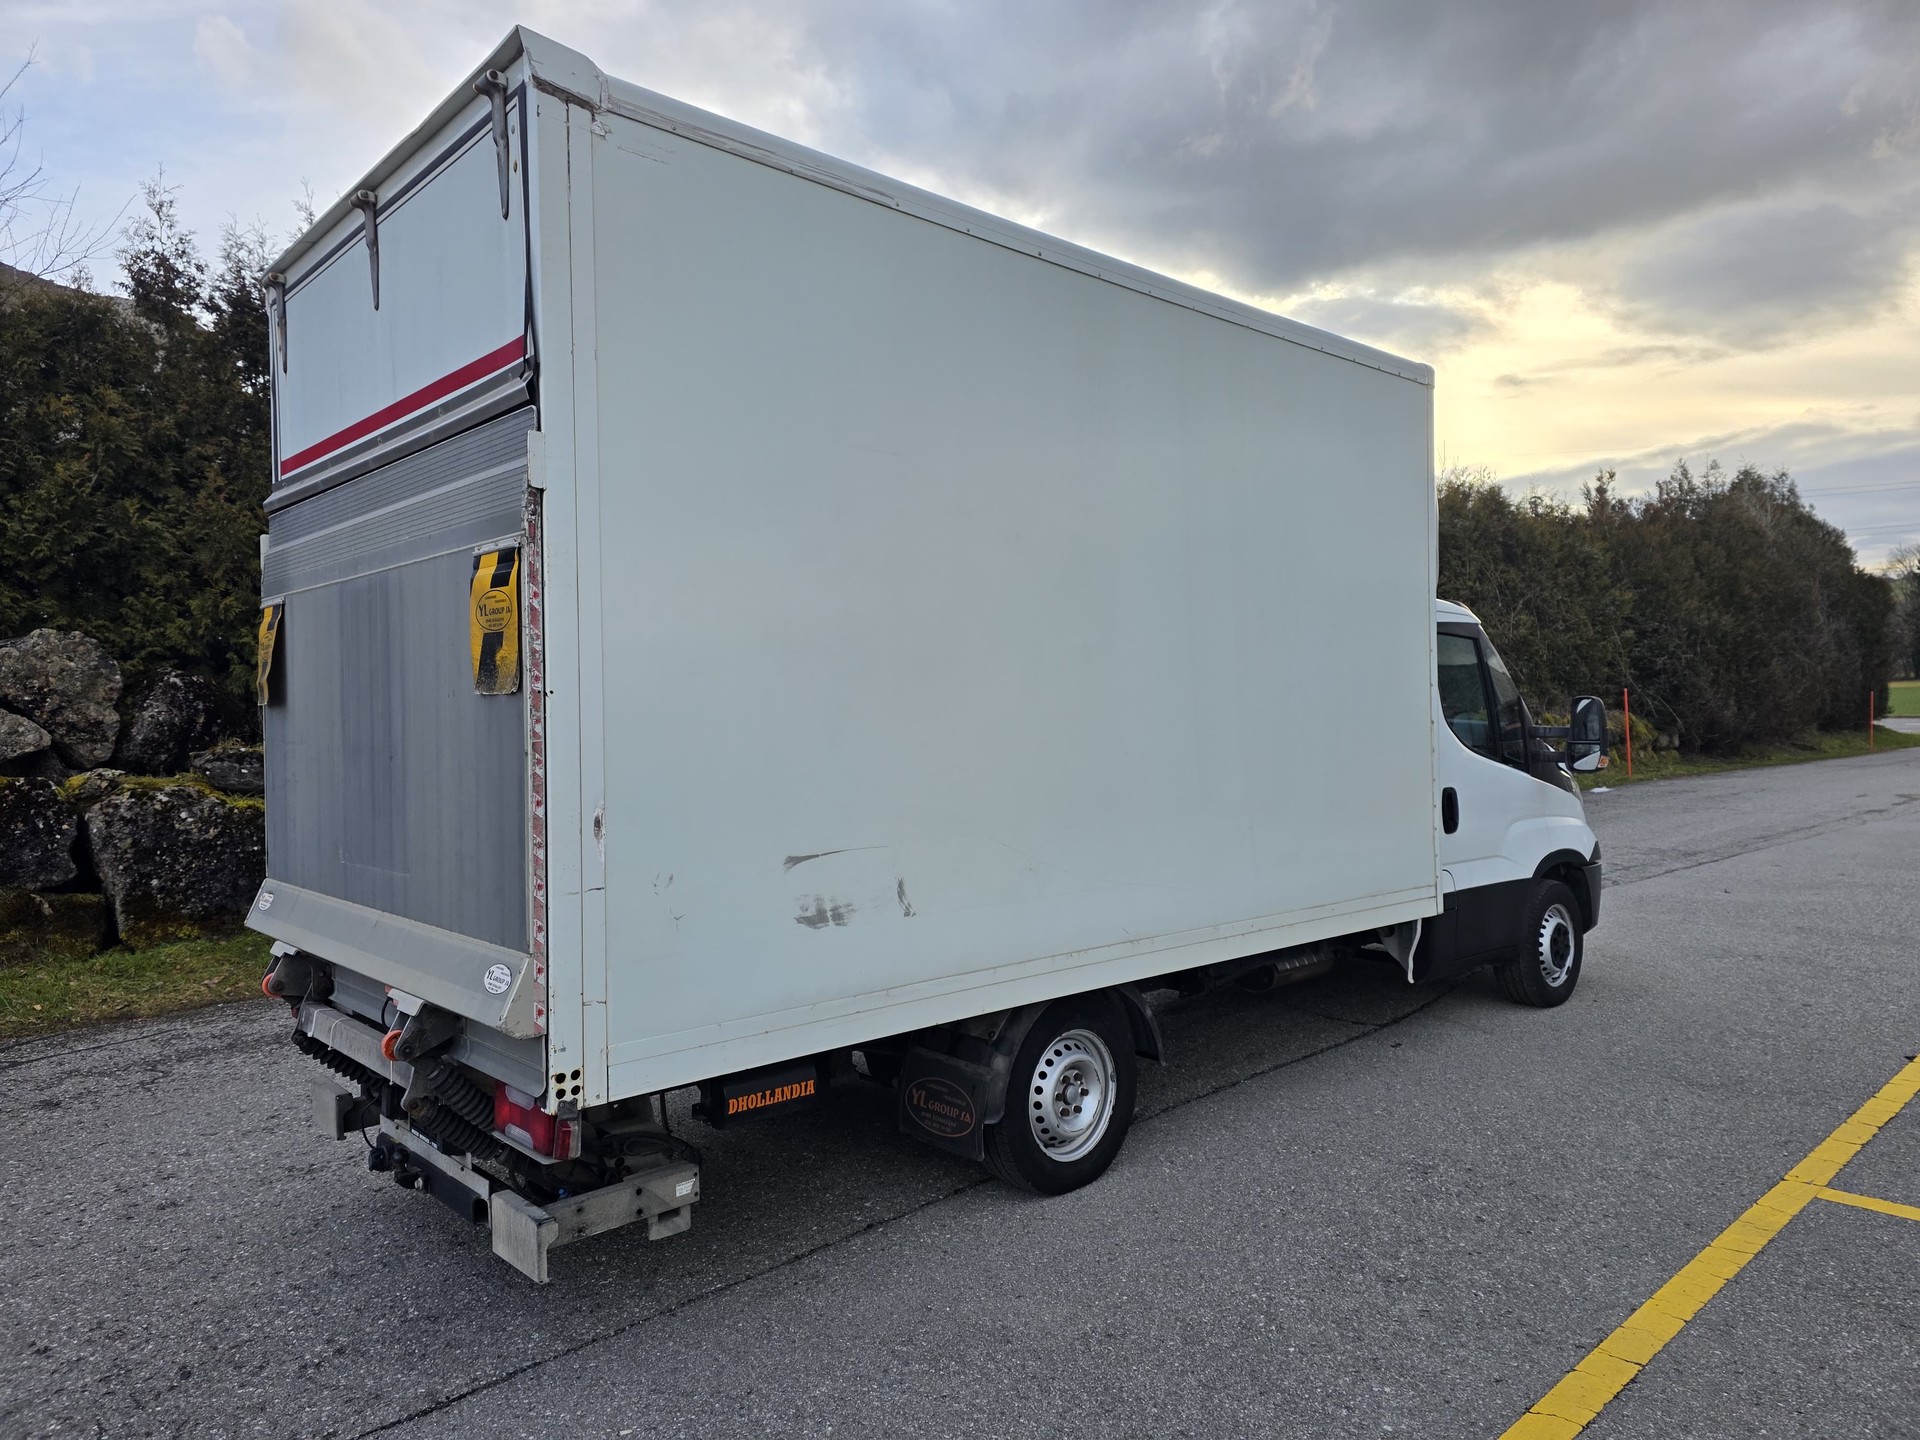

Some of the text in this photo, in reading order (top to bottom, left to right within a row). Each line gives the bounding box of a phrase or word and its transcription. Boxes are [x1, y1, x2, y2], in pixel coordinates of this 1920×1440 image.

[479, 604, 488, 616] YL
[489, 607, 504, 615] GROUP
[728, 1080, 814, 1115] DHOLLANDIA
[912, 1087, 927, 1108] YL
[928, 1100, 959, 1118] GROUP
[960, 1111, 971, 1124] SA
